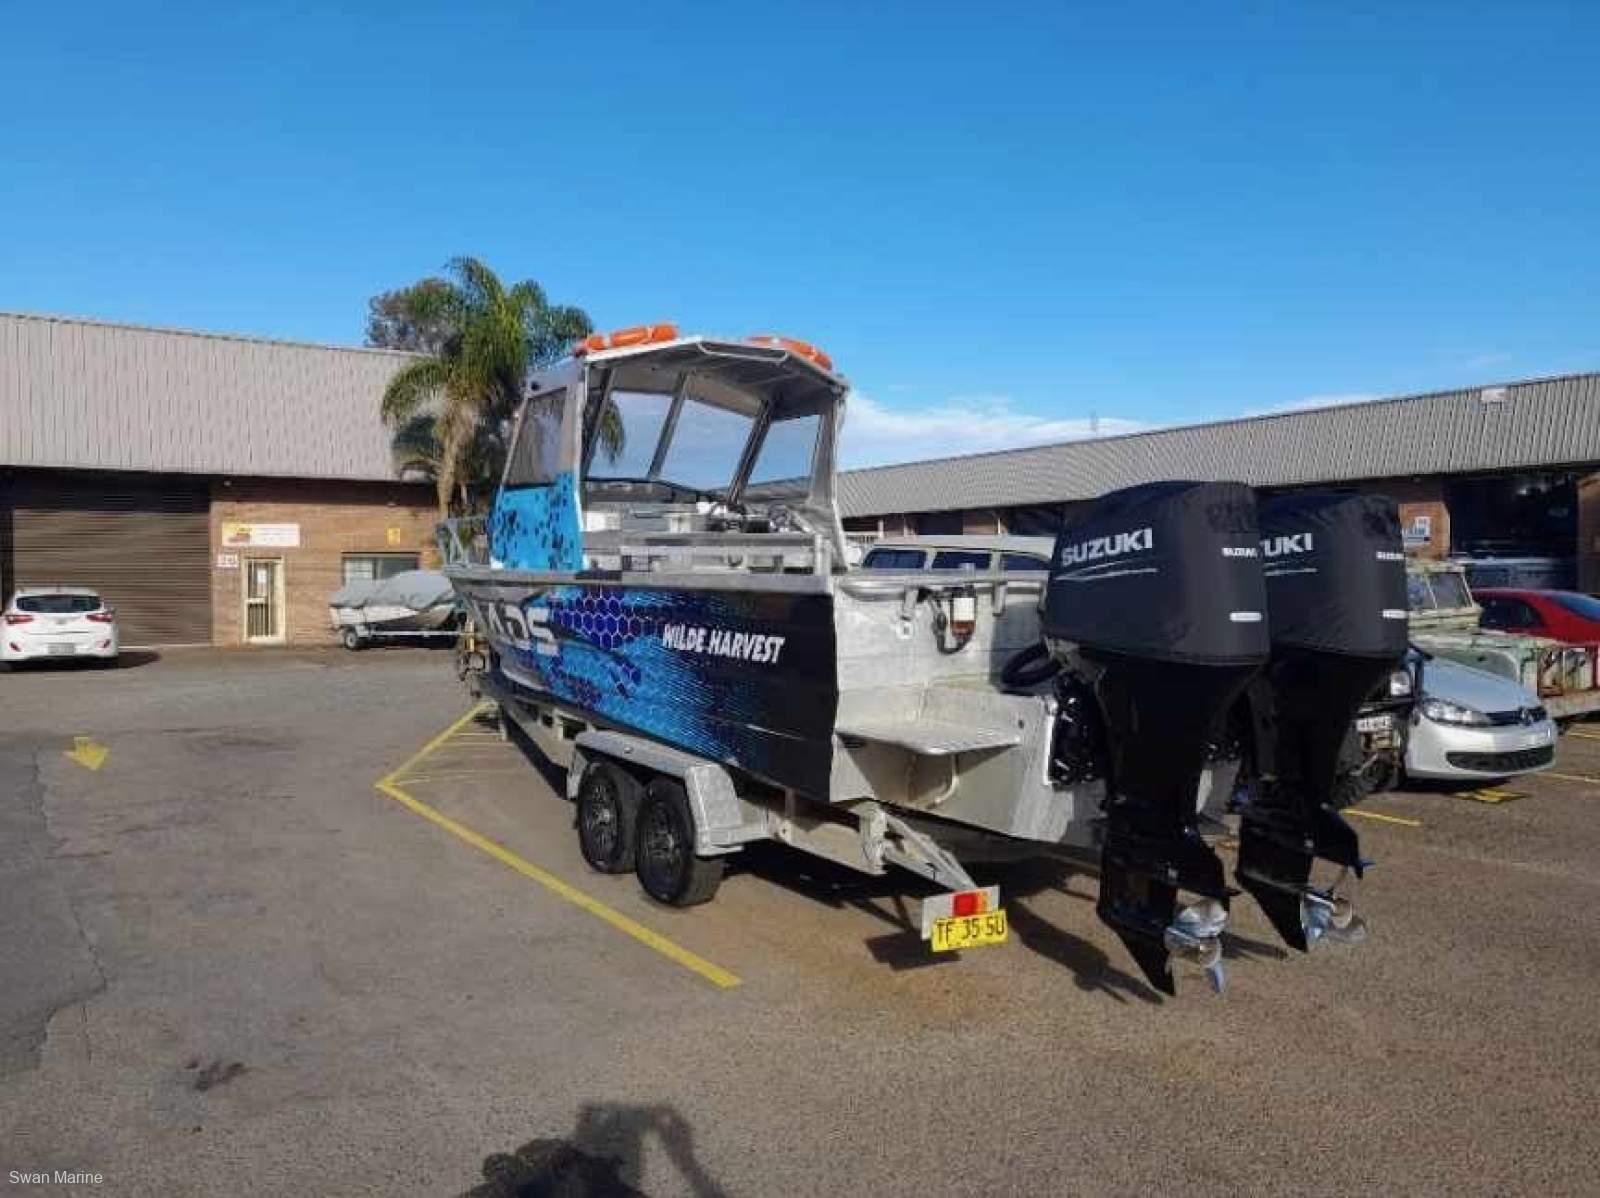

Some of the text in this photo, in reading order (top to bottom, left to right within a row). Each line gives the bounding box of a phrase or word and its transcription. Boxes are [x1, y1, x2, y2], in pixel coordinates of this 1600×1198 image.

[1061, 527, 1153, 566] SUZUKI
[662, 623, 786, 663] WILDE HARVEST
